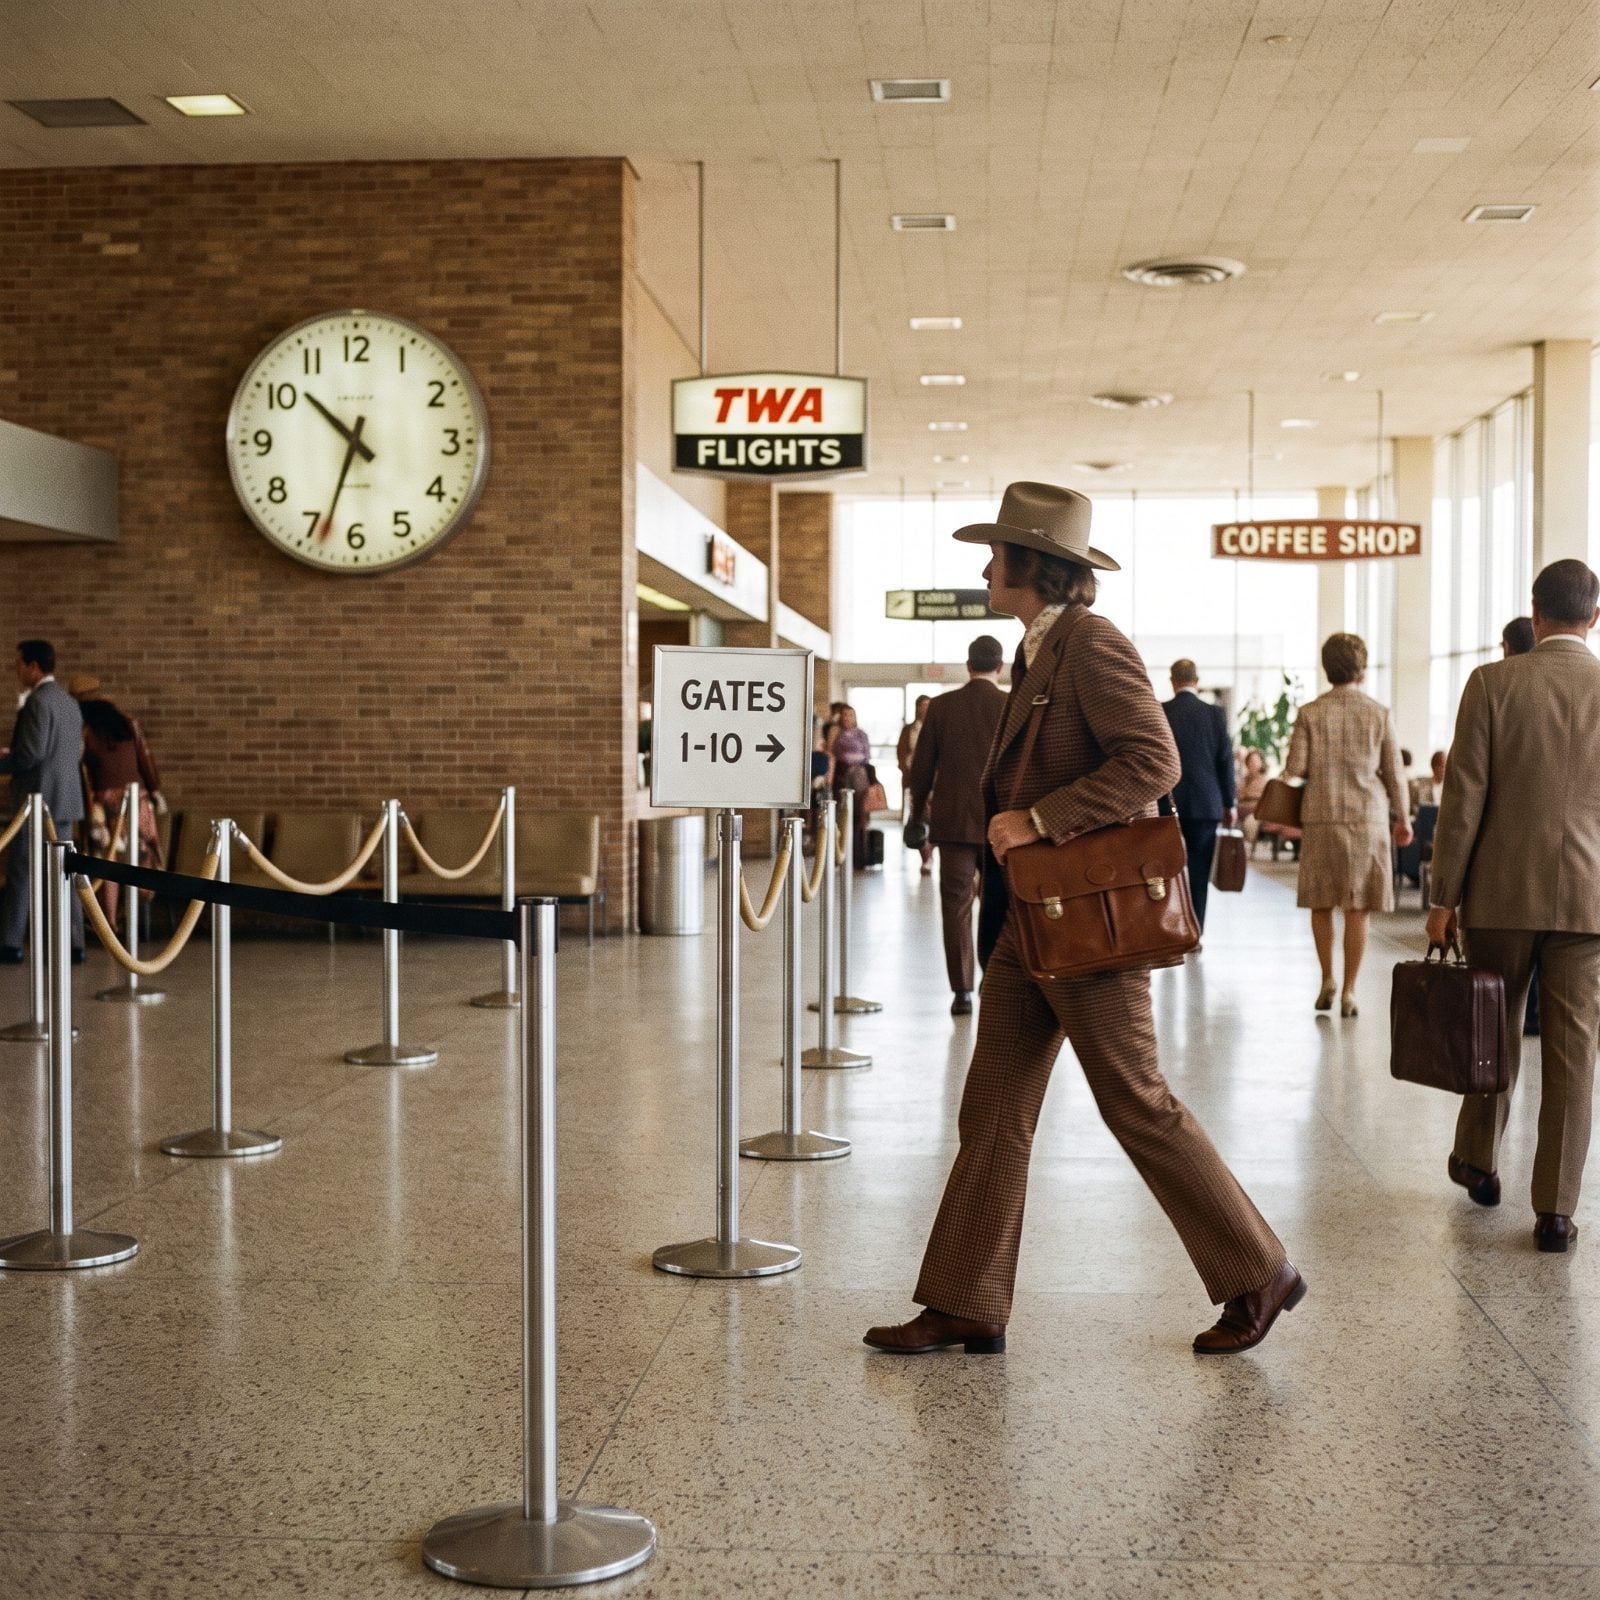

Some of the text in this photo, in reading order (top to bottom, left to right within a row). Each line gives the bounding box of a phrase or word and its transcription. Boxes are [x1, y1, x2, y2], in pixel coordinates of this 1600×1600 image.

[303, 347, 321, 375] 11
[343, 335, 370, 363] 12
[268, 382, 297, 410] 10
[427, 380, 446, 408] 2
[713, 387, 824, 424] TWA
[252, 429, 273, 457] 9
[440, 428, 461, 457] 3
[697, 438, 842, 467] FLIGHTS
[267, 475, 288, 505] 8
[425, 475, 447, 503] 4
[302, 511, 321, 540] 7
[346, 522, 366, 551] 6
[392, 511, 412, 538] 5
[1220, 526, 1417, 555] COFFEE SHOP
[680, 679, 786, 713] GATES
[680, 732, 743, 764] 1-10
